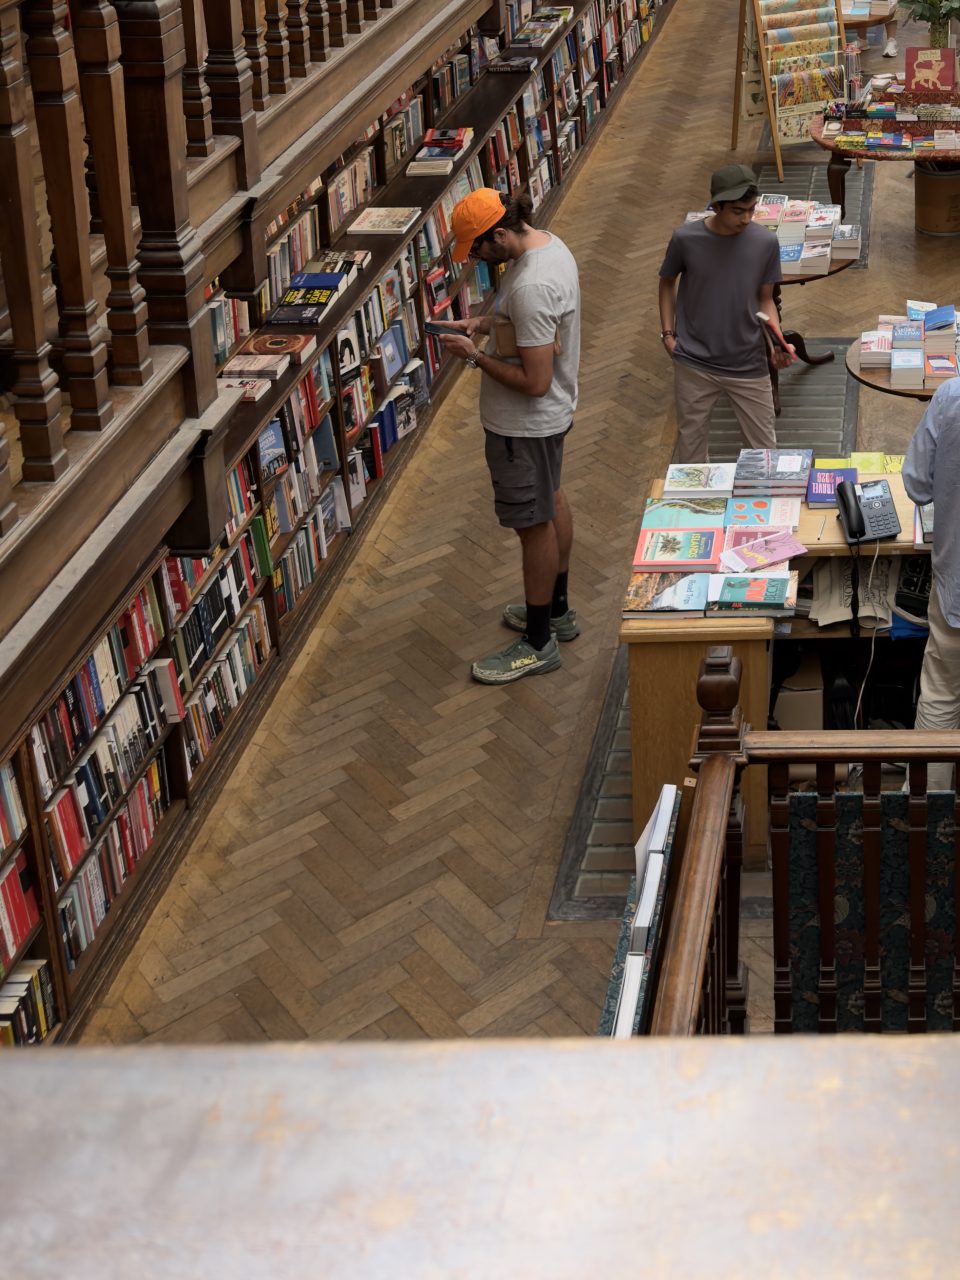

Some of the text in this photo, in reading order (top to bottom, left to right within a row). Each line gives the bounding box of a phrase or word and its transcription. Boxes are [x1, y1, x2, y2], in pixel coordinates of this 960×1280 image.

[817, 472, 835, 483] 2026
[811, 482, 835, 495] TRAVEL
[688, 533, 701, 558] ISLANDS
